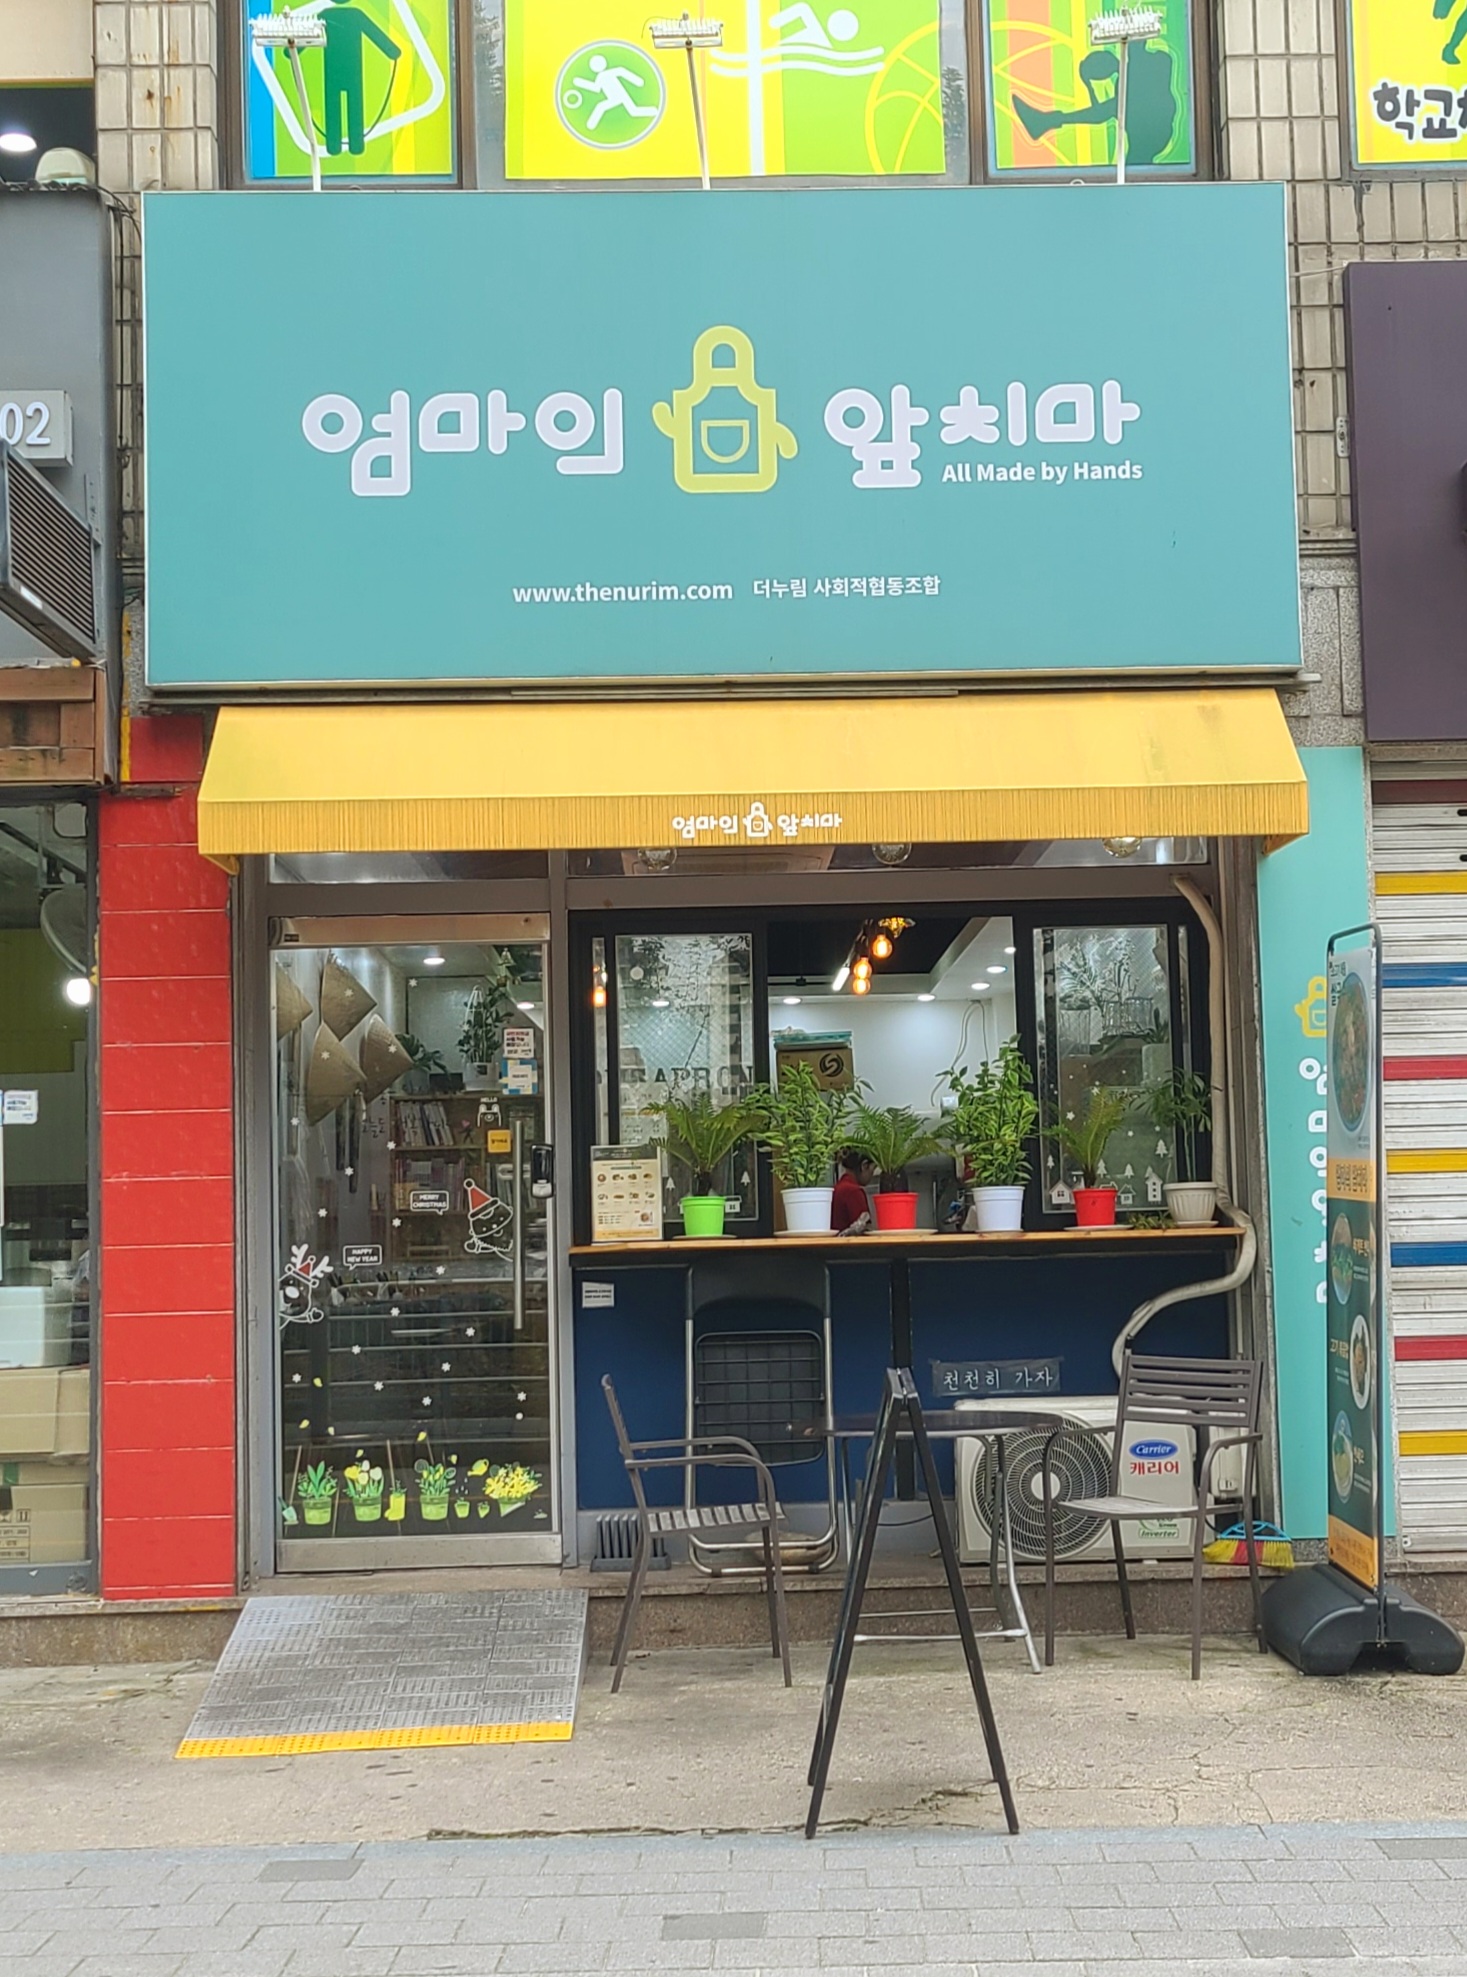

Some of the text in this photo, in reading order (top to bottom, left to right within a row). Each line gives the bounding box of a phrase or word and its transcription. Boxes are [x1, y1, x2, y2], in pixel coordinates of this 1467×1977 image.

[302, 380, 1141, 496] 엄마의 앞치마
[942, 460, 1143, 485] All Made by Hands
[512, 581, 733, 602] www.thenurim.com
[753, 575, 941, 599] 더누림 사회적협동조합
[672, 813, 843, 839] 엄마의 앞치마
[943, 1366, 1054, 1391] 천천히 가자
[1135, 1444, 1173, 1455] Carrier
[1130, 1460, 1180, 1475] 캐리어
[1140, 1529, 1178, 1538] Inverter
